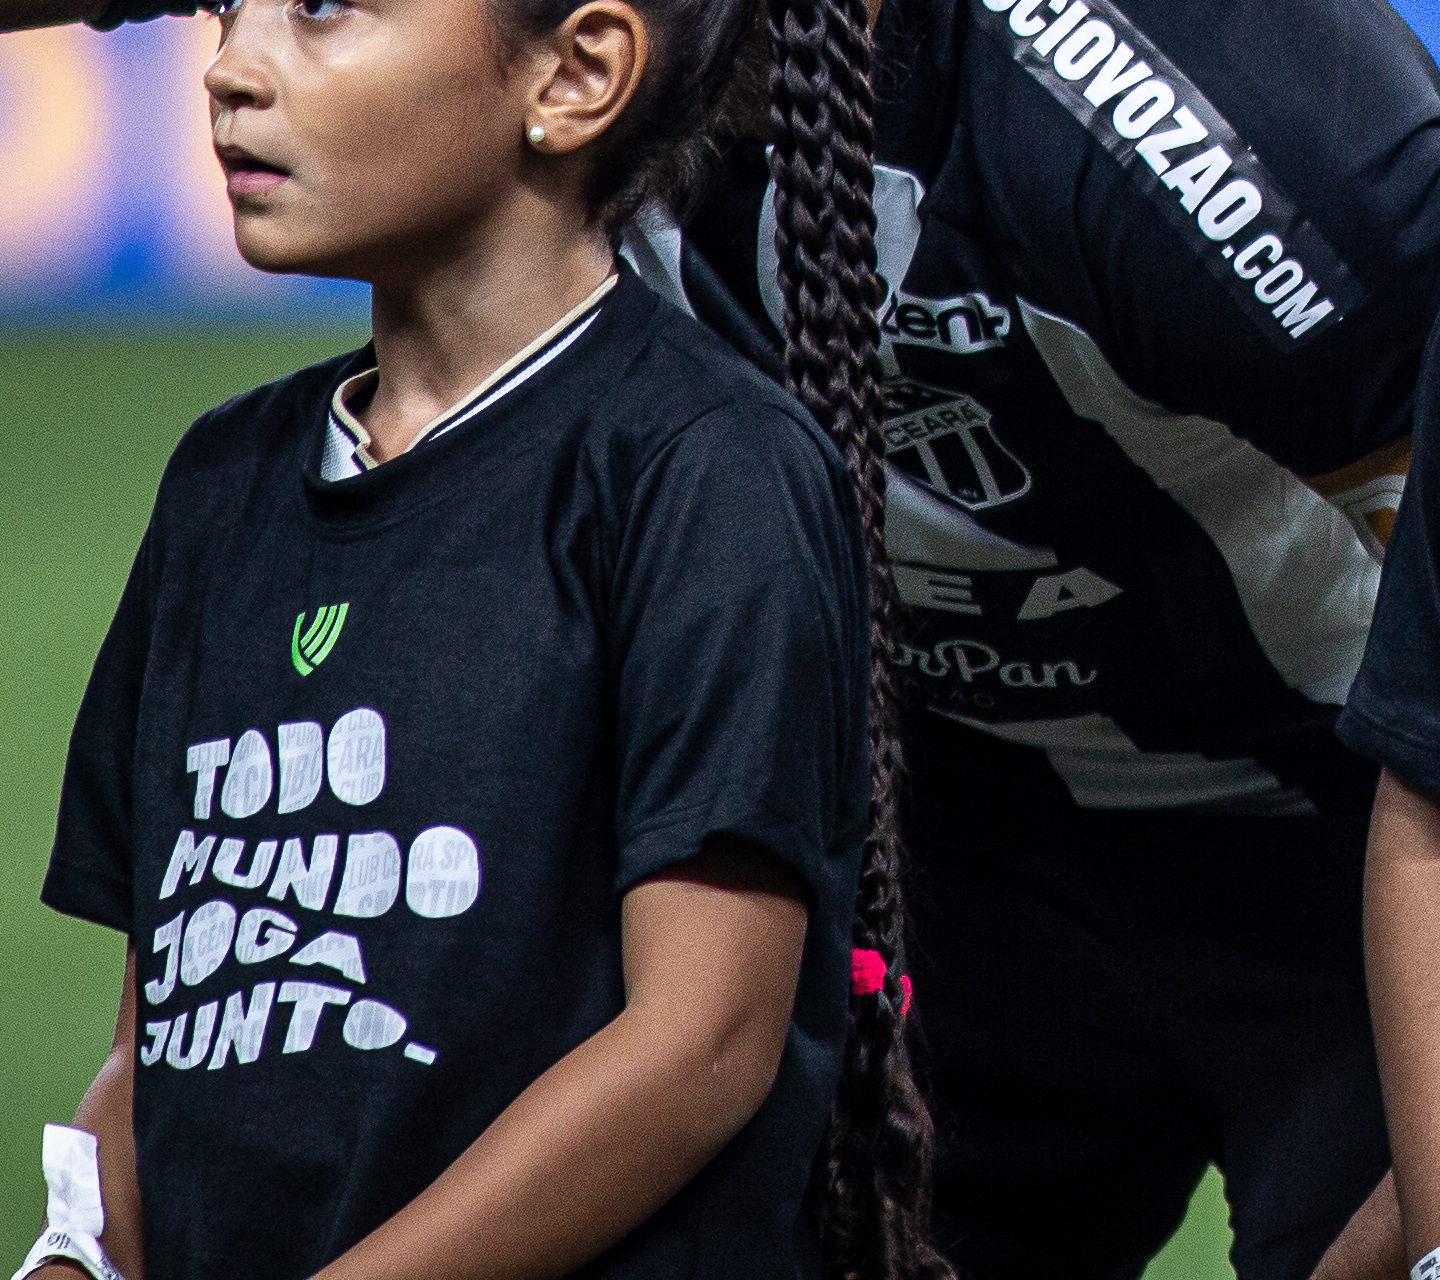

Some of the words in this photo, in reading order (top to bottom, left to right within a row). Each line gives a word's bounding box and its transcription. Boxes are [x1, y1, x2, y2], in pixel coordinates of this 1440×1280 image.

[187, 707, 387, 820] TODO
[158, 825, 480, 919] MUNDO
[144, 898, 368, 1006] JOGA
[140, 980, 439, 1071] JUNTO.
